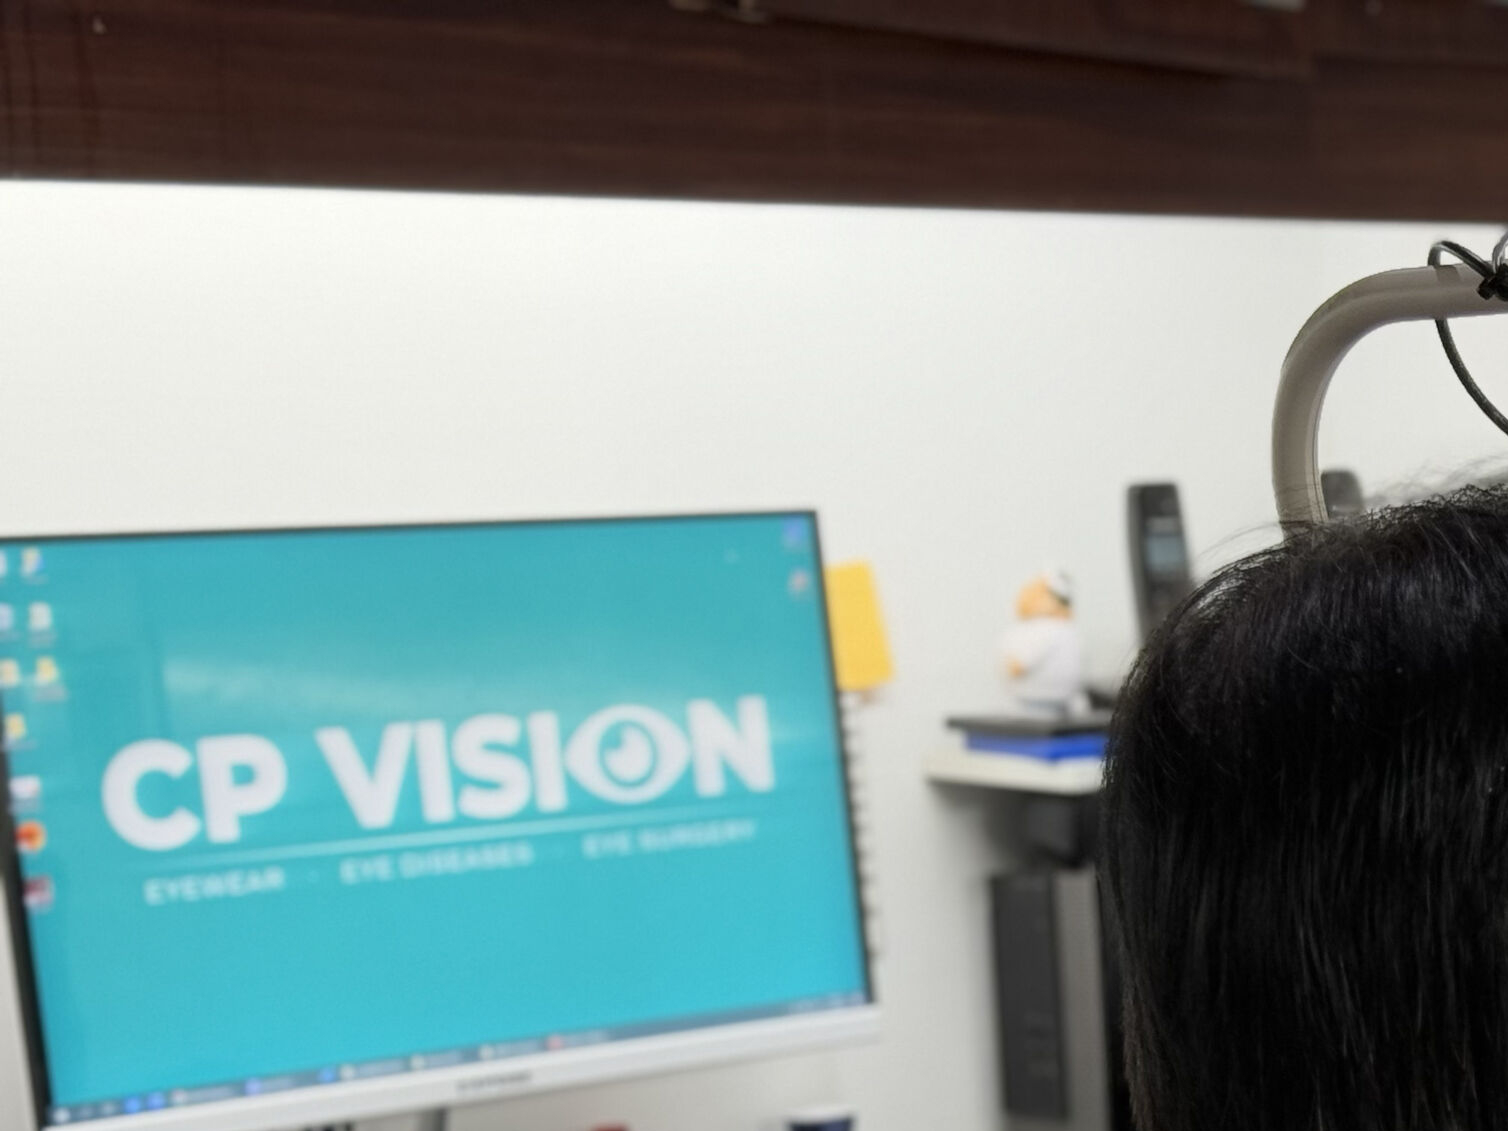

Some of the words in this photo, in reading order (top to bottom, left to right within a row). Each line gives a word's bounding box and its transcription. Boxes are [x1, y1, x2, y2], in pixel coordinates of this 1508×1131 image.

[101, 733, 288, 851] CP
[315, 694, 776, 829] VISION
[144, 866, 285, 905] EYEWEAR
[340, 854, 393, 884] EYE
[399, 840, 534, 879] DISEASES
[582, 831, 630, 860] EYE
[638, 818, 756, 853] SURGERY
